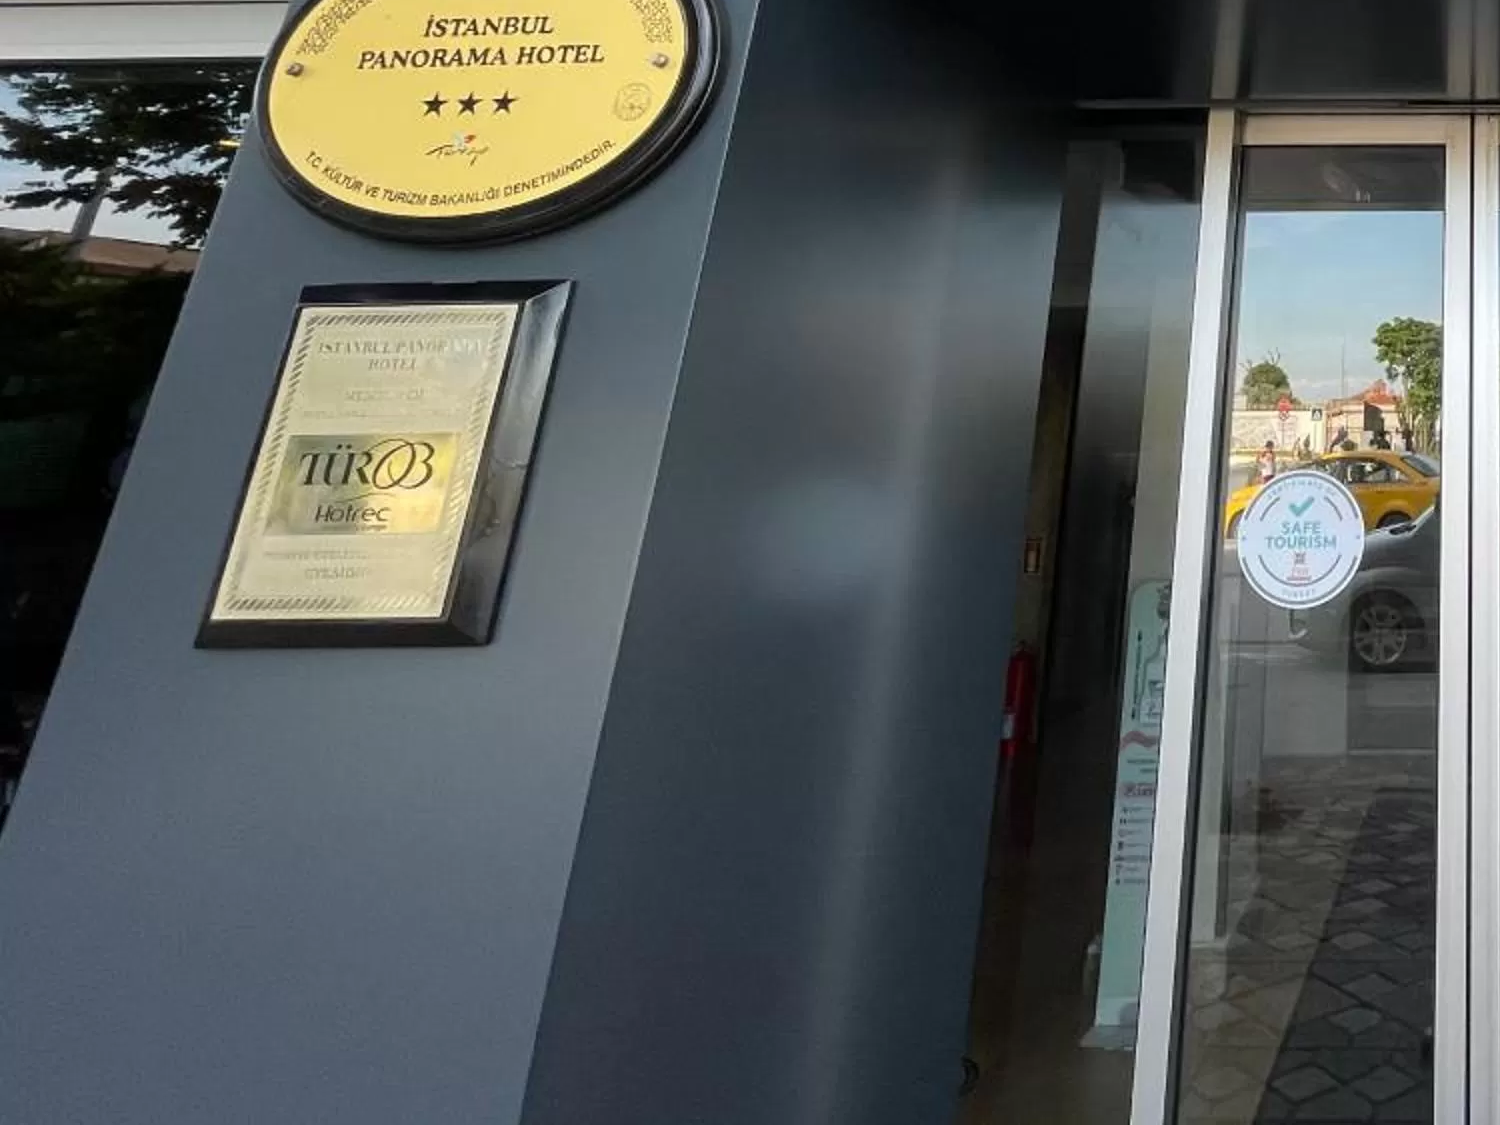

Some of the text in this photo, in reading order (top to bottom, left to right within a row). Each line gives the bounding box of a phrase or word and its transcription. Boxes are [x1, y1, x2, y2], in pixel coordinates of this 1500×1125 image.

[424, 14, 554, 38] İSTANBUL
[357, 43, 605, 70] PANORAMA HOTEL
[364, 184, 380, 198] VE
[299, 438, 435, 490] TÜROB
[1280, 520, 1321, 535] SAFE
[1264, 535, 1337, 550] TOURISM
